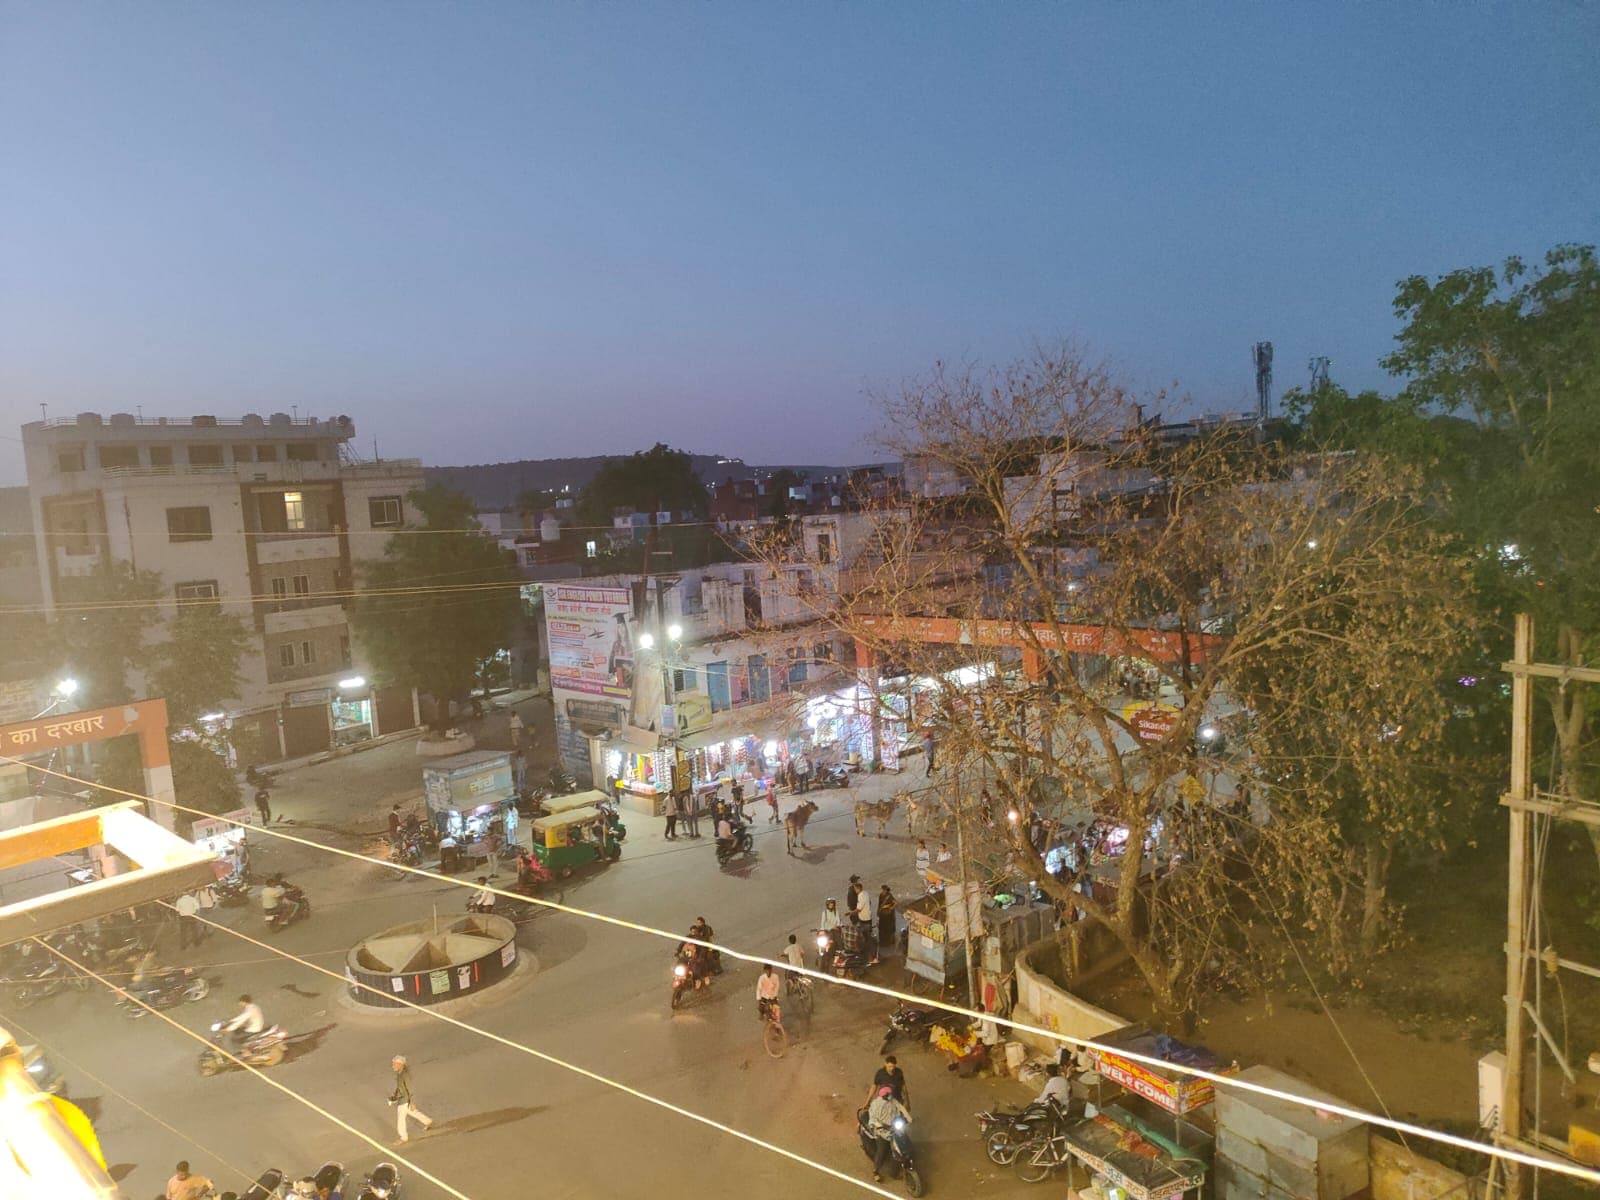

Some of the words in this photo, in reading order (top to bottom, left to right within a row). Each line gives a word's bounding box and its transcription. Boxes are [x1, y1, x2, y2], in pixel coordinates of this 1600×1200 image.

[8, 727, 38, 745] का
[43, 715, 105, 739] दरबार
[1138, 720, 1171, 732] Sikanda
[1139, 730, 1163, 741] Kamp
